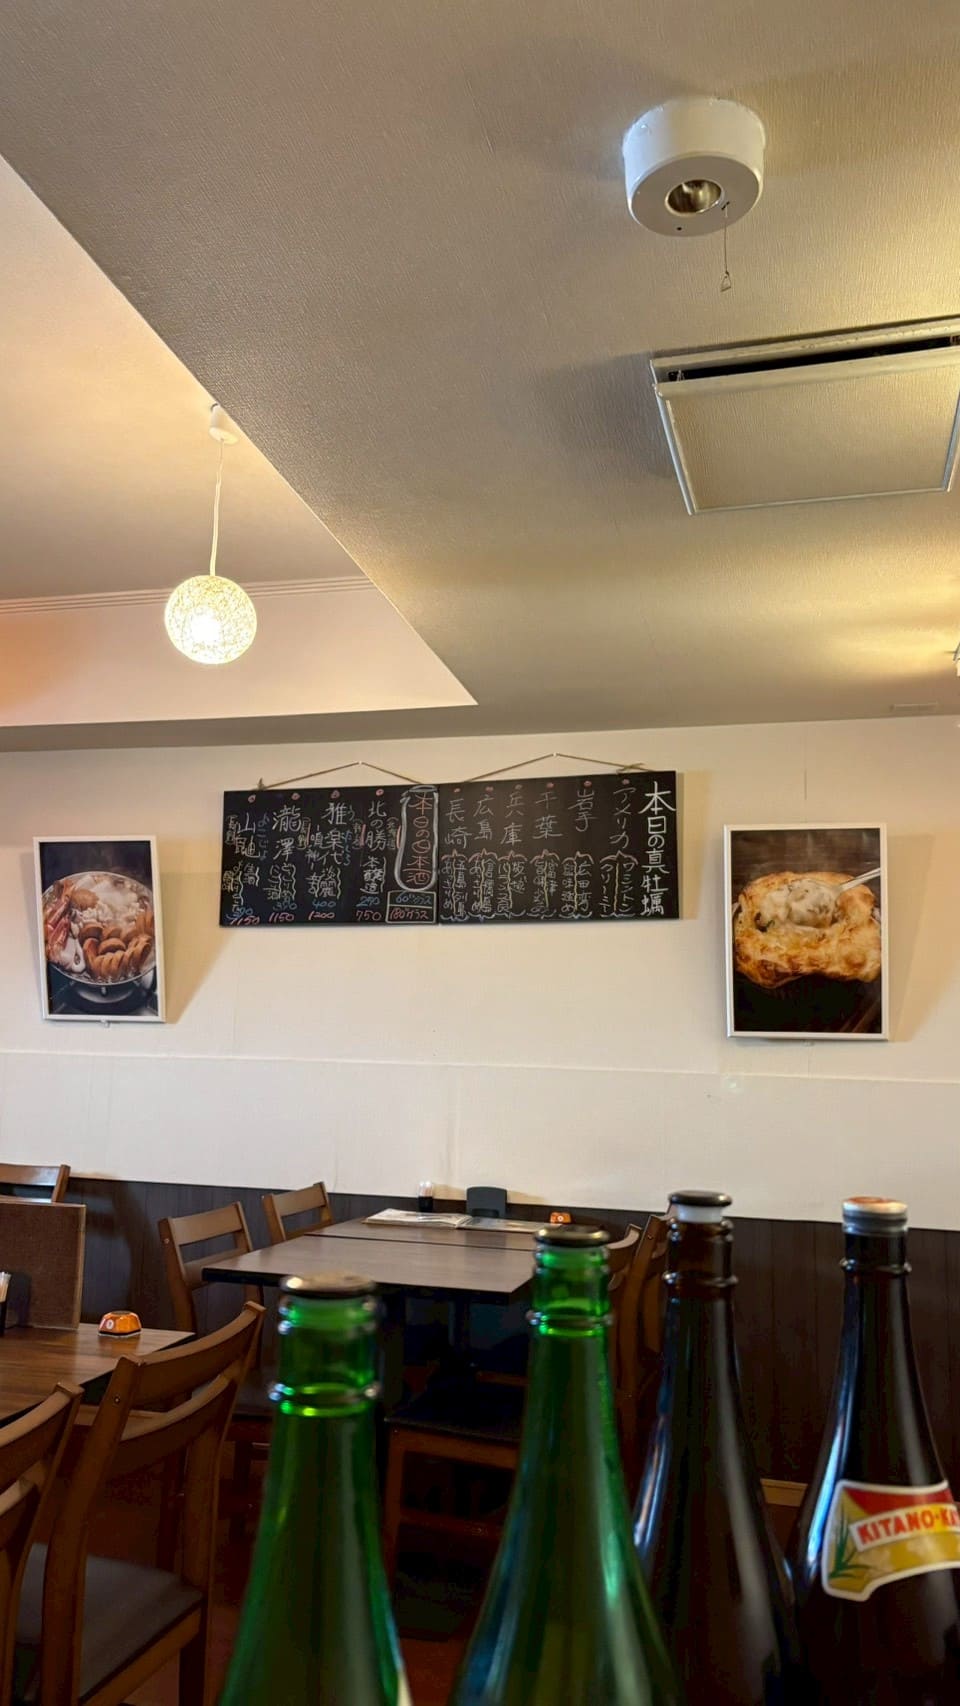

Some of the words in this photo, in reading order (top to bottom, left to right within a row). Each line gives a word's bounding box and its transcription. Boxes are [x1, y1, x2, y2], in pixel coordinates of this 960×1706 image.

[366, 800, 387, 852] 北の勝
[445, 798, 473, 848] 長崎
[473, 794, 495, 841] 広島
[500, 791, 525, 845] 兵庫
[533, 790, 563, 839] 千葉
[569, 789, 598, 832] 岩手
[610, 786, 637, 849] アメリカ
[405, 792, 433, 886] 本日の日本酒
[639, 780, 676, 916] 本日の真牡蠣
[269, 911, 294, 922] 1150
[308, 911, 335, 920] 1200
[311, 899, 336, 909] 400
[356, 909, 381, 921] 750
